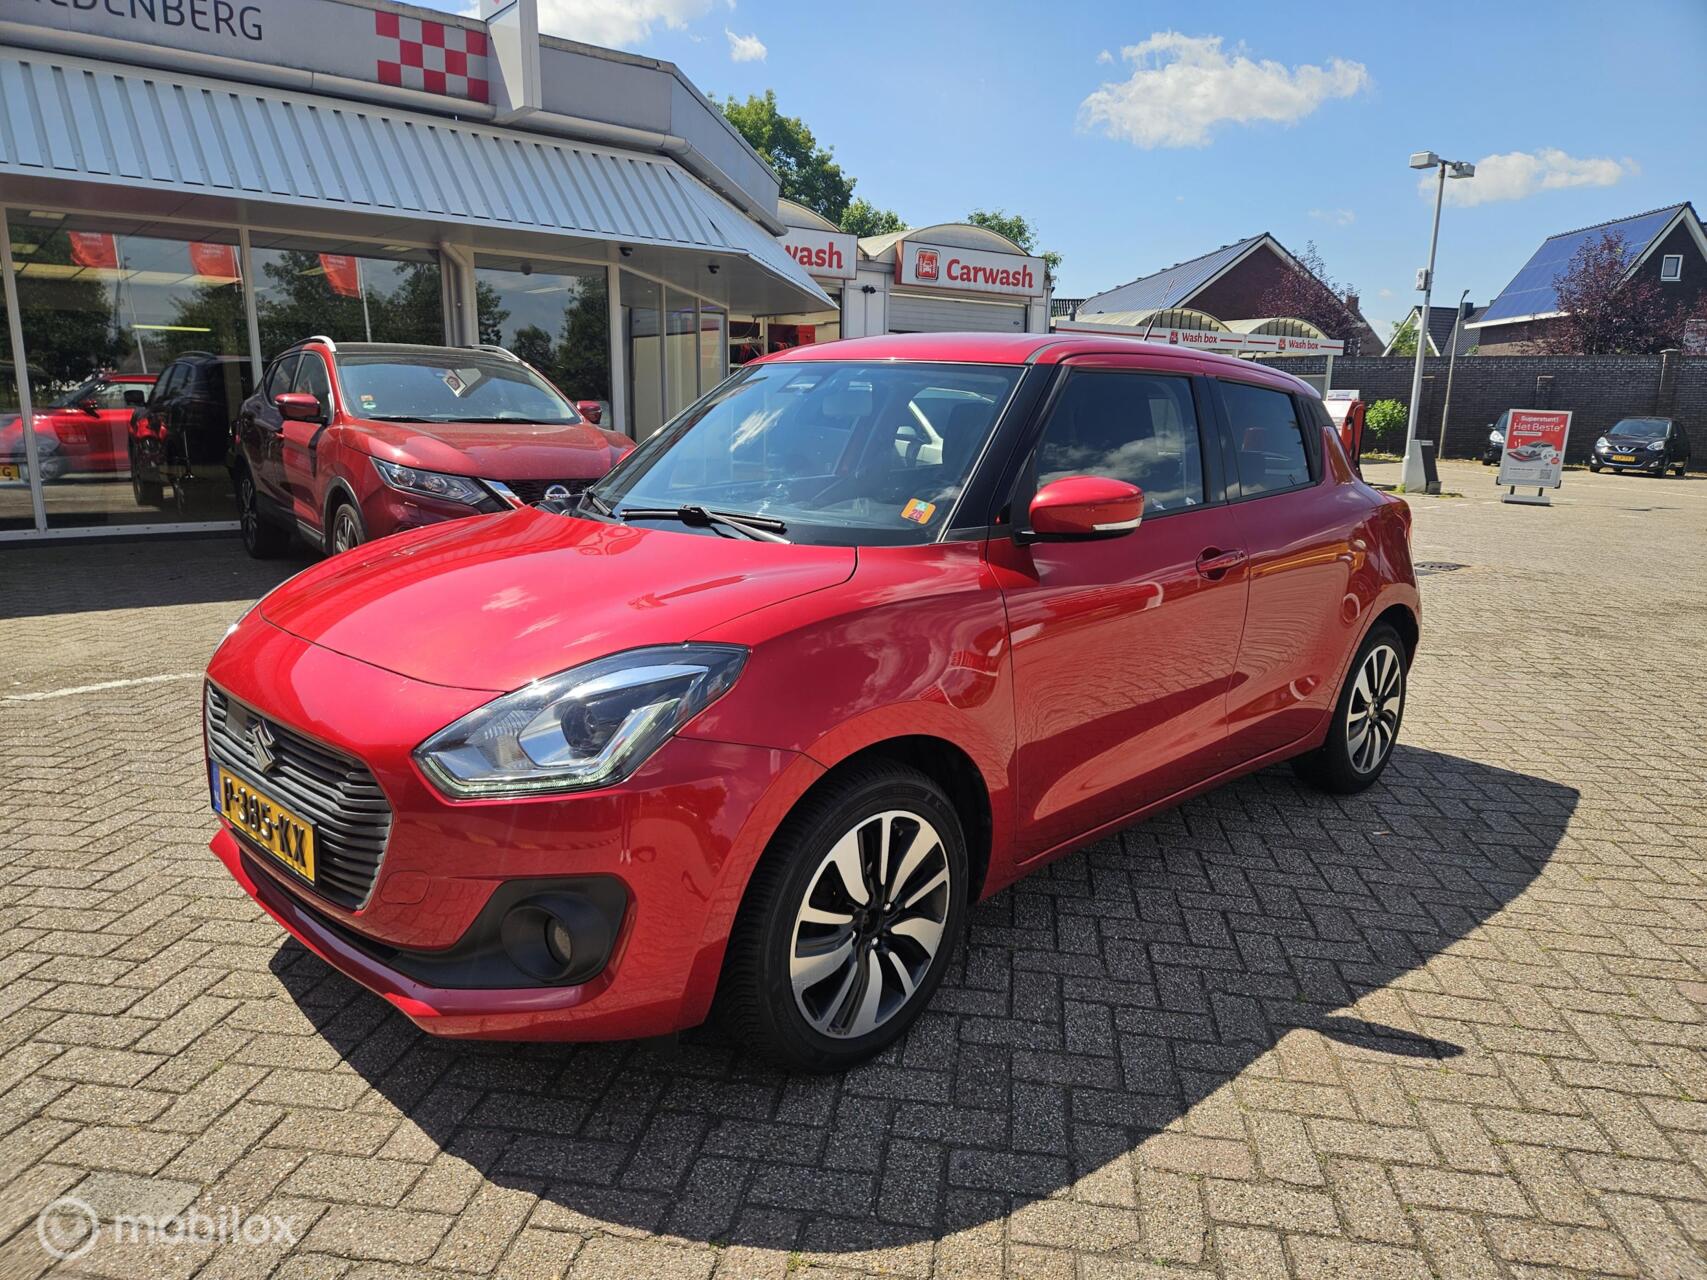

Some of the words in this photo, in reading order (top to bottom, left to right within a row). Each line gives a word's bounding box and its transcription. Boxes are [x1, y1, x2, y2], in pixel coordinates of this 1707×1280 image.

[36, 0, 263, 41] NBERG
[946, 258, 1034, 289] Carwash
[1182, 333, 1202, 343] Wash
[1204, 333, 1218, 344] box
[1289, 340, 1307, 349] Wash
[1307, 340, 1319, 350] box
[1513, 422, 1531, 431] Het
